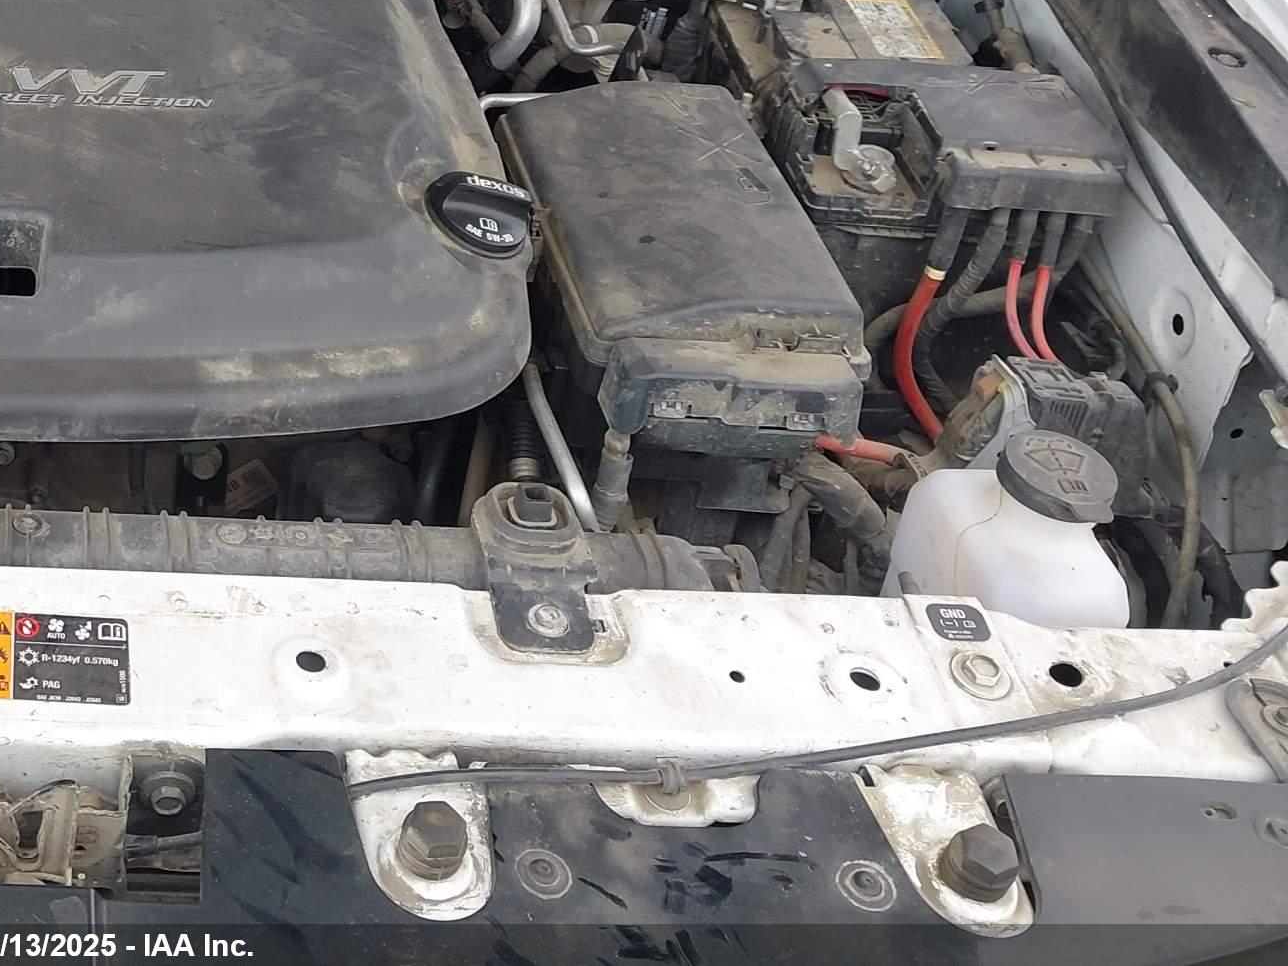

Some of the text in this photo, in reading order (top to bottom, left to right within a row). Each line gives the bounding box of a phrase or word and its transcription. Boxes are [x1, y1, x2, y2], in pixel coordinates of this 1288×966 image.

[11, 66, 168, 97] VVT
[73, 93, 215, 109] INJECTION
[466, 175, 525, 198] dexos
[465, 223, 514, 243] SAE 5W-30
[938, 608, 967, 619] GND
[46, 632, 66, 640] AUTO
[41, 653, 119, 667] R-1234yf 0.570kg
[42, 680, 61, 689] PAG
